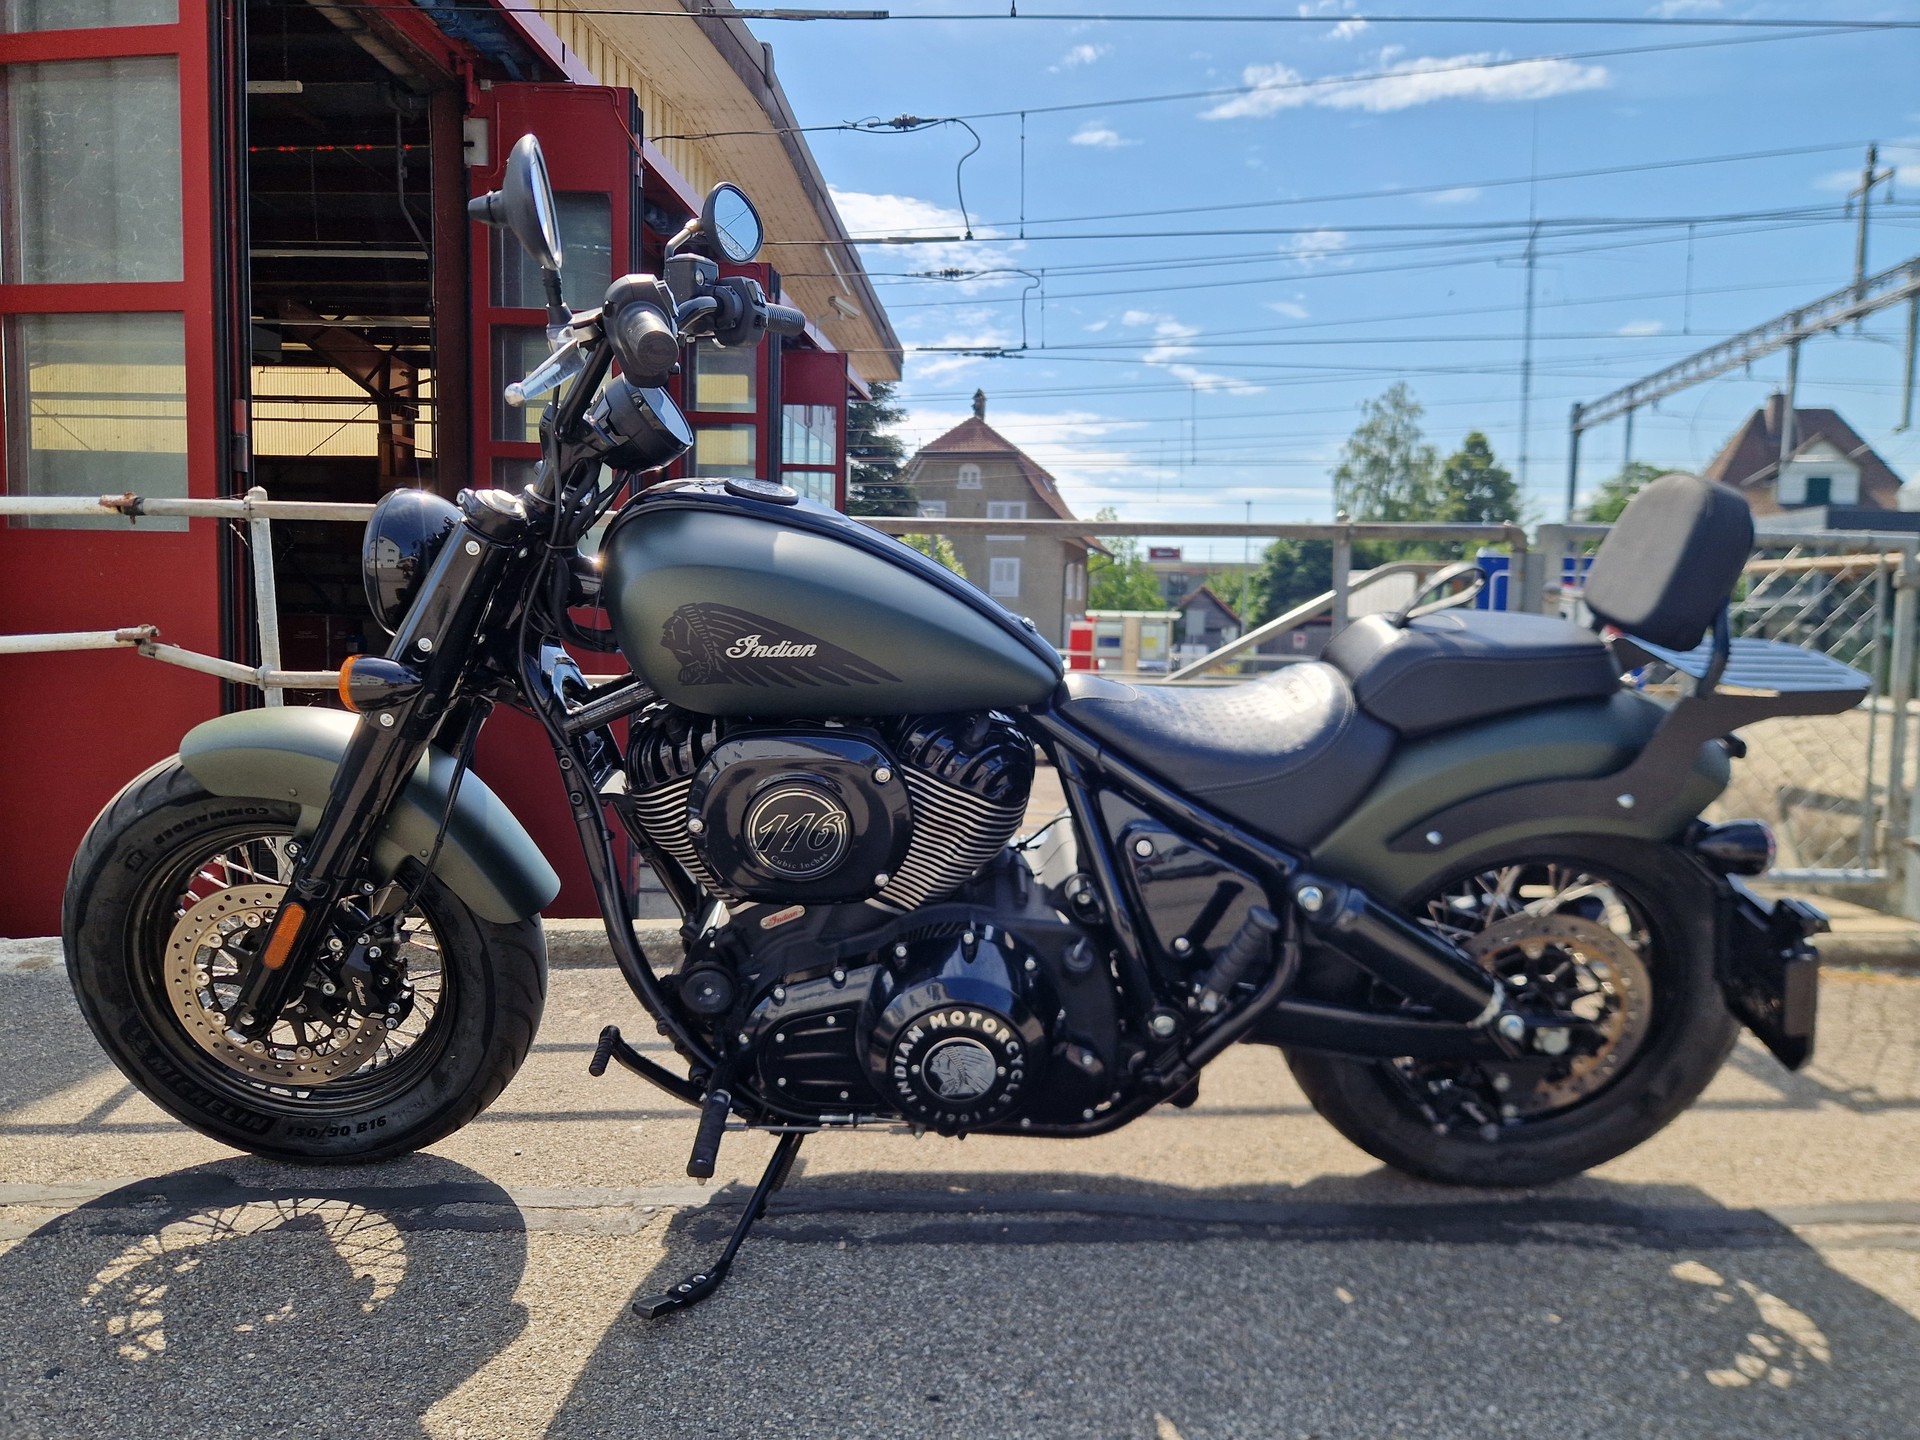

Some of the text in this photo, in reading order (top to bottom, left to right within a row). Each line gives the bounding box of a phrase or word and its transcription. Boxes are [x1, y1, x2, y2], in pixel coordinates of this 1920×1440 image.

[725, 634, 817, 659] Indian
[755, 810, 847, 853] 116
[771, 853, 828, 869] Cubic Inches
[768, 910, 798, 926] Indian
[351, 976, 367, 1006] Indian
[894, 1010, 1024, 1104] INDIAN MOTORCYCLE
[147, 1057, 268, 1130] MICHELIN
[286, 1115, 387, 1140] 130/90 B16
